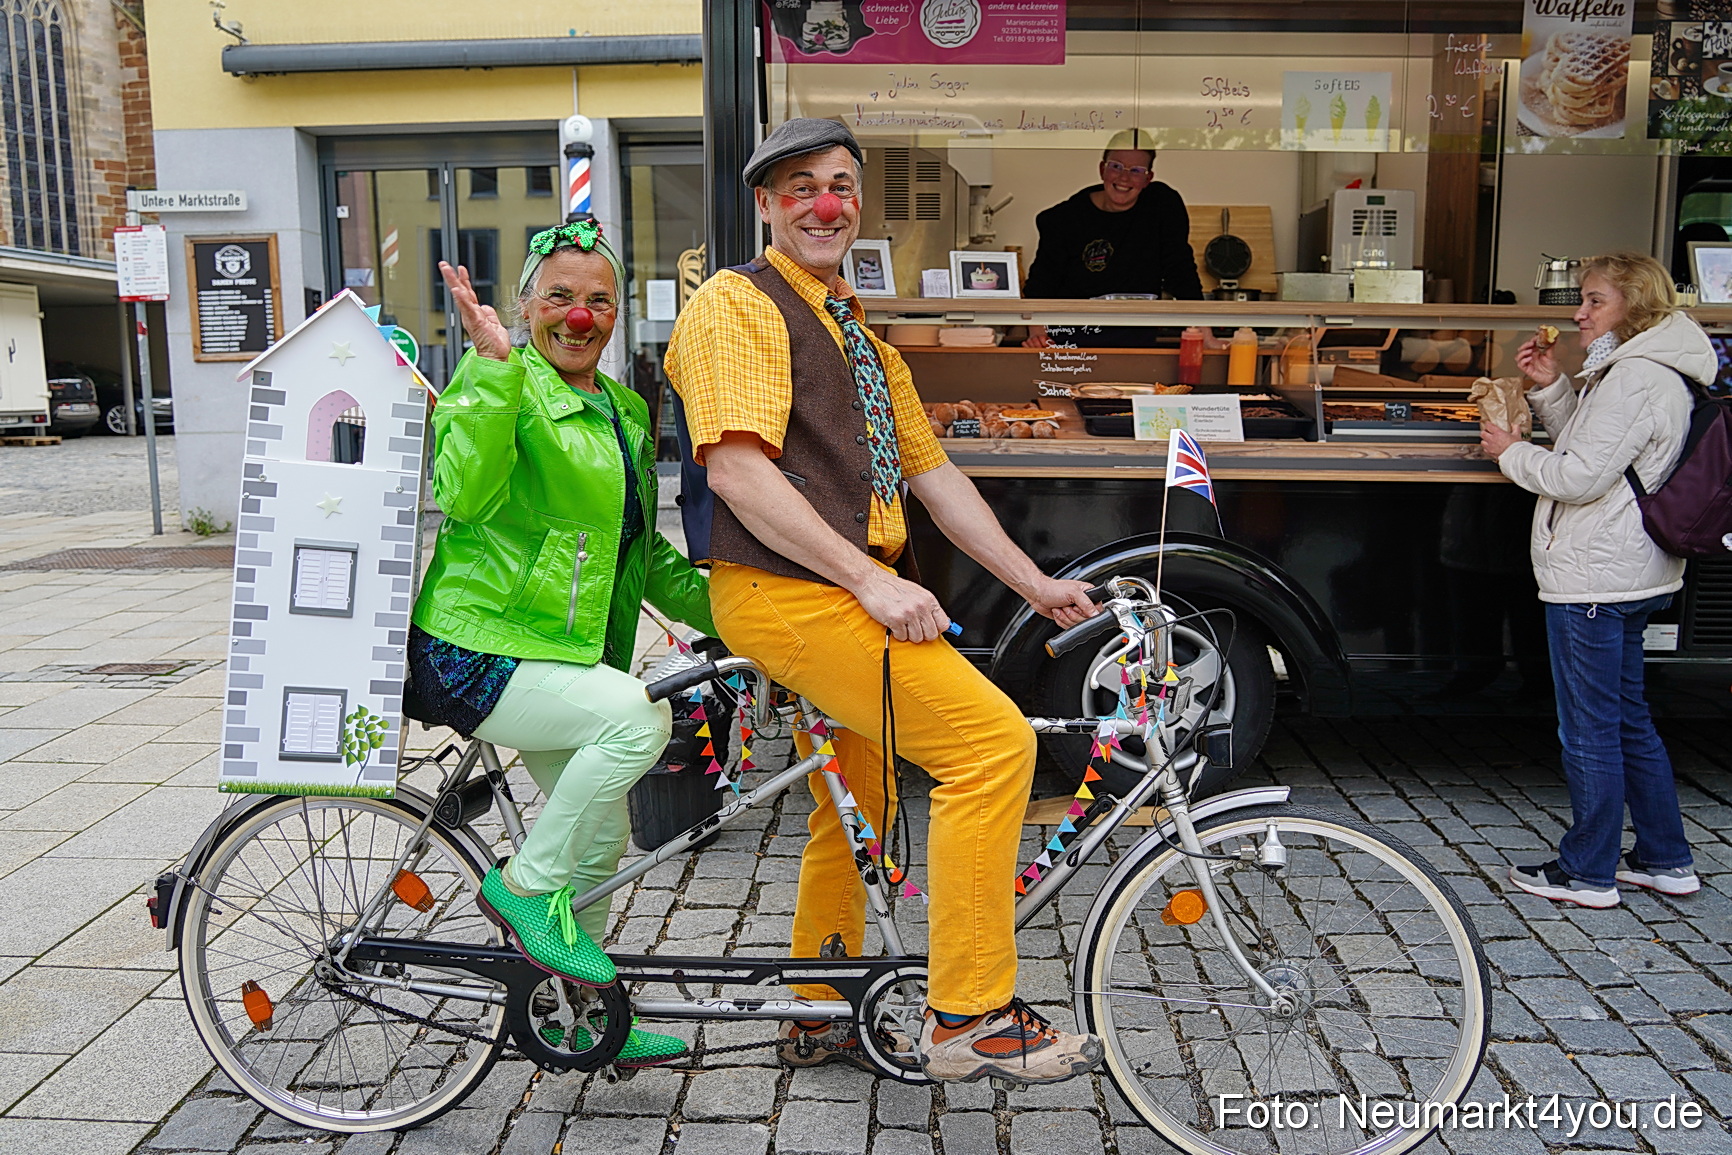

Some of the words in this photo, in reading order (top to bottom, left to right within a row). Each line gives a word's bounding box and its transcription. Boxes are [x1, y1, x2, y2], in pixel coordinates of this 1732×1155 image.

[866, 3, 909, 13] schmeckt
[988, 2, 1014, 10] andere
[1017, 2, 1058, 10] Leckereien
[1532, 0, 1626, 22] Waffeln
[876, 15, 899, 25] Liebe
[1022, 27, 1058, 35] Pavelsbach
[1200, 77, 1250, 101] Softeis
[1679, 120, 1705, 132] und
[179, 193, 241, 207] Marktstraße
[1038, 381, 1071, 397] Sahne
[1191, 405, 1230, 413] Wundertüte
